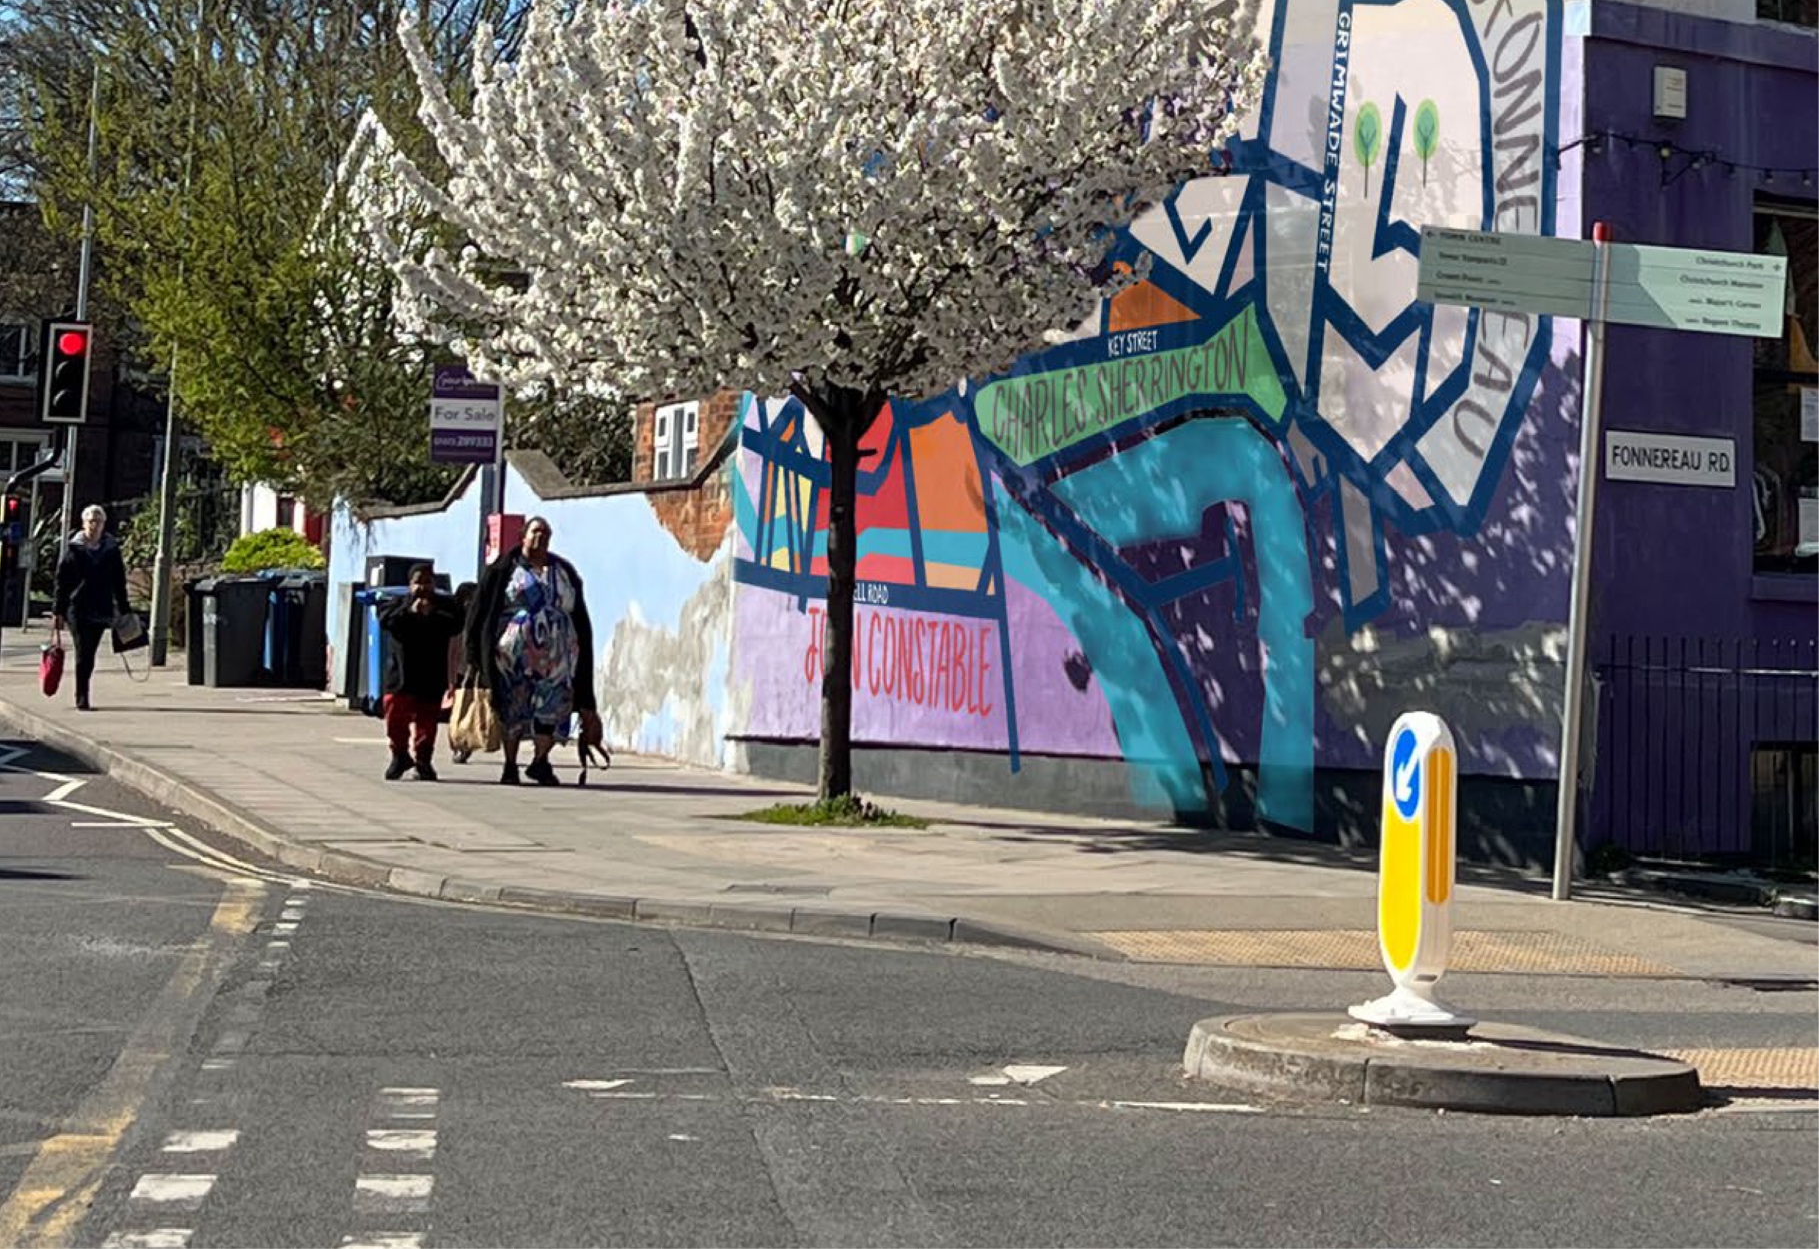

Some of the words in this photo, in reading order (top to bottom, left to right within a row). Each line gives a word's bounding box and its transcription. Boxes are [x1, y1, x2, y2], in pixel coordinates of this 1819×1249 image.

[1325, 11, 1351, 165] GRIMWADE
[1317, 178, 1336, 272] STREET
[992, 367, 1087, 460] CHARLES
[1096, 315, 1250, 426] SHERRINGTON
[1108, 334, 1125, 357] KEY
[1126, 330, 1158, 353] STREET
[434, 405, 459, 420] For
[464, 407, 495, 422] Sale
[1612, 445, 1700, 471] FONNEREAU
[868, 609, 993, 717] CONSTABLE
